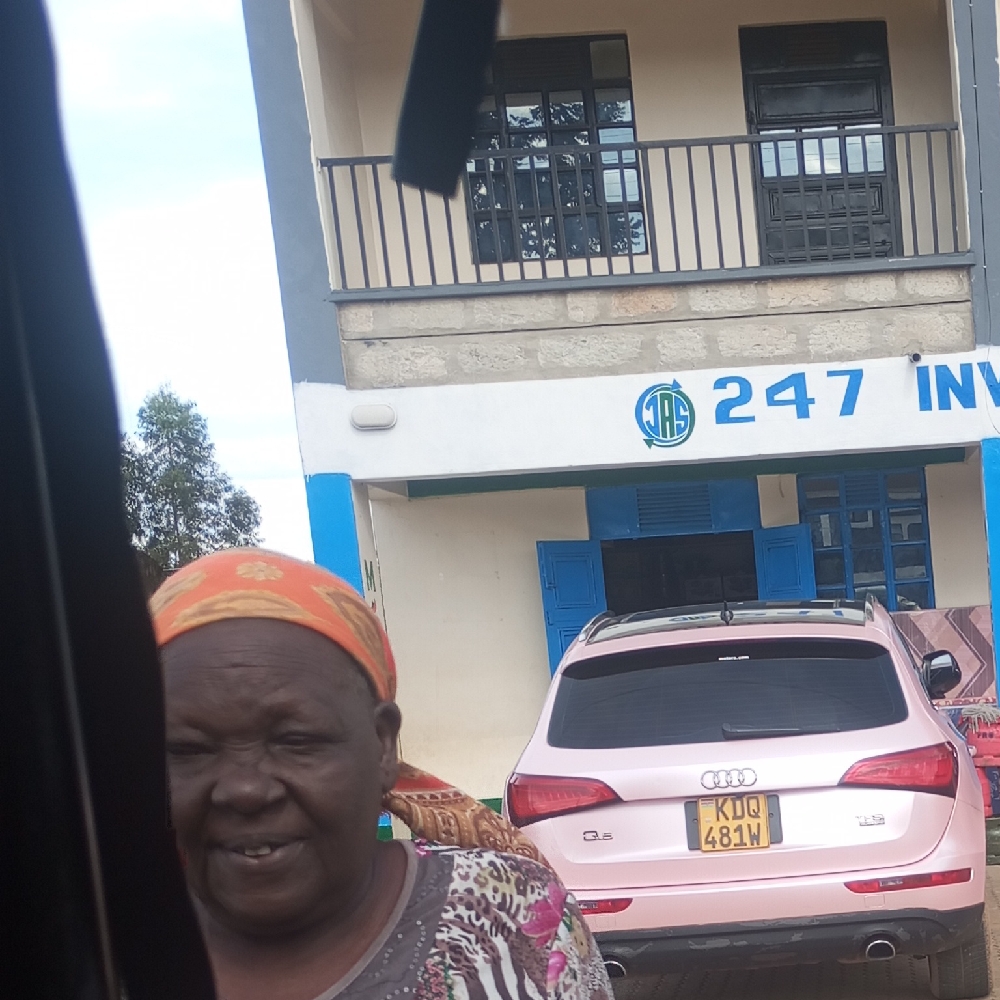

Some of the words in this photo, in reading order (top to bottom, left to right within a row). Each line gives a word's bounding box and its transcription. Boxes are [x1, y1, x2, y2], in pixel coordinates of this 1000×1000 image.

[713, 368, 863, 424] 247
[714, 796, 761, 822] KDQ
[704, 823, 760, 848] 481W
